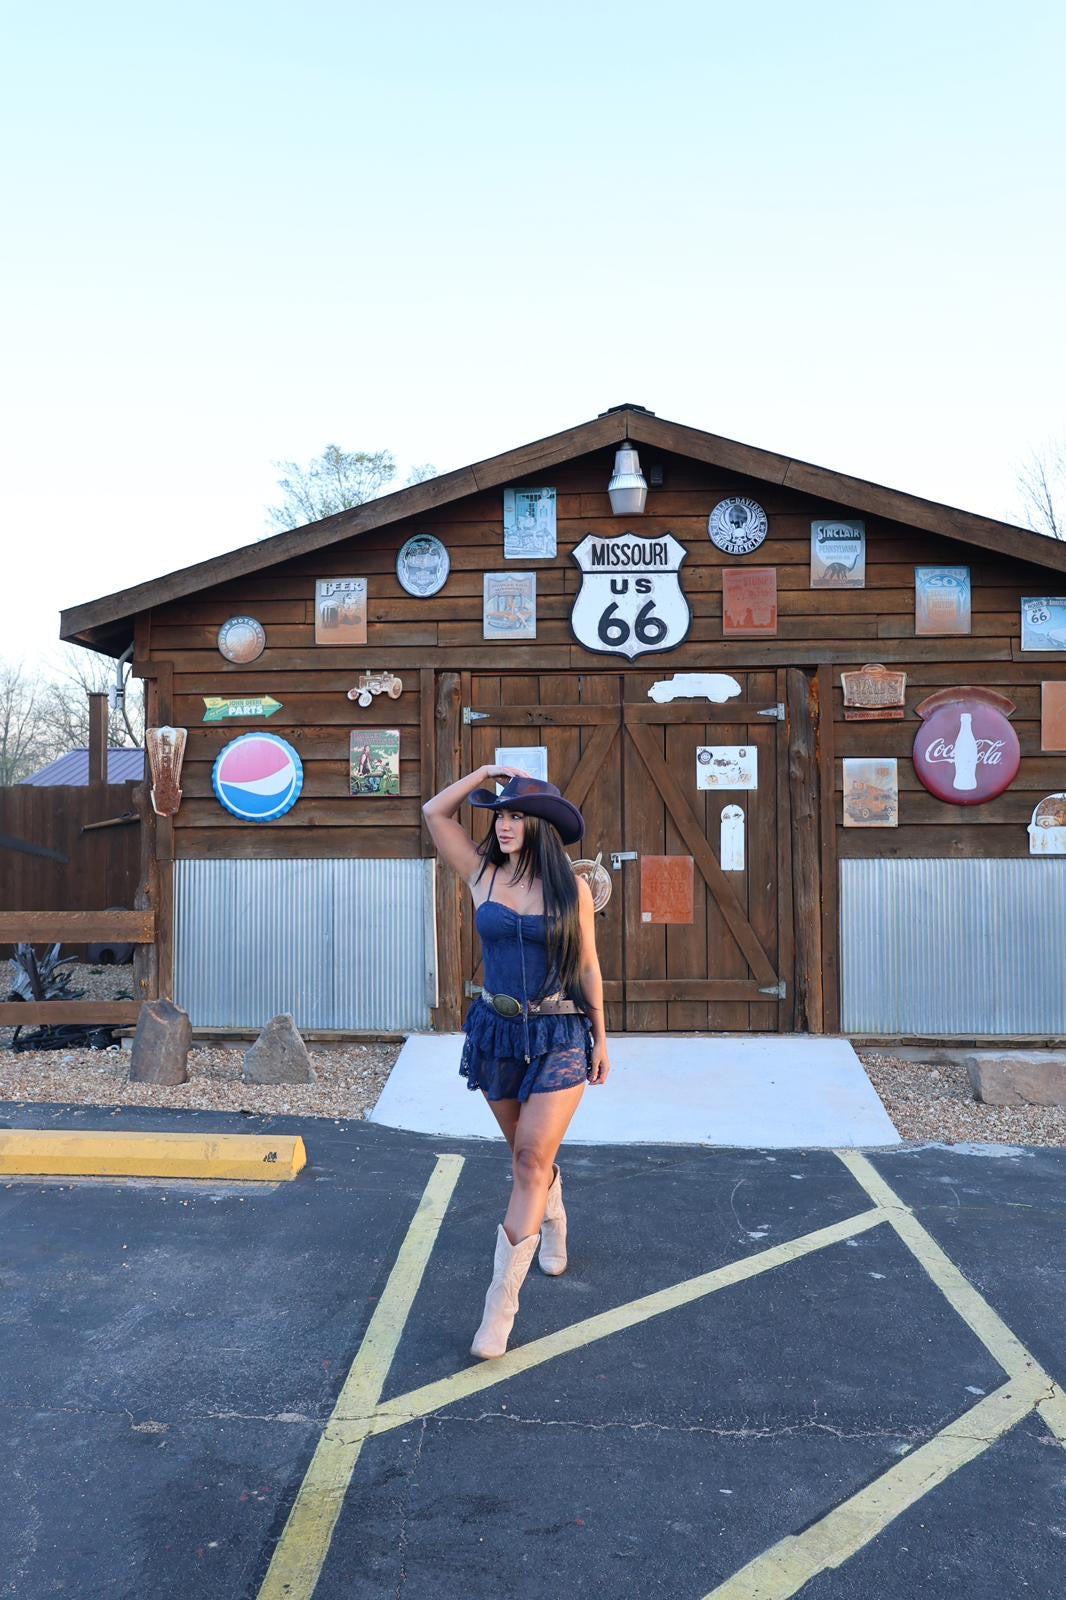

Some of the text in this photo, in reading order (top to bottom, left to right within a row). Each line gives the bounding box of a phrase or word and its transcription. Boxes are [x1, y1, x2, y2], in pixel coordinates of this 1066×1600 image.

[817, 526, 860, 540] SINCLAIR
[591, 543, 668, 566] MISSOURI
[320, 582, 364, 597] BEER
[597, 600, 668, 647] 66
[1031, 611, 1048, 624] 66
[228, 705, 264, 715] PARTS
